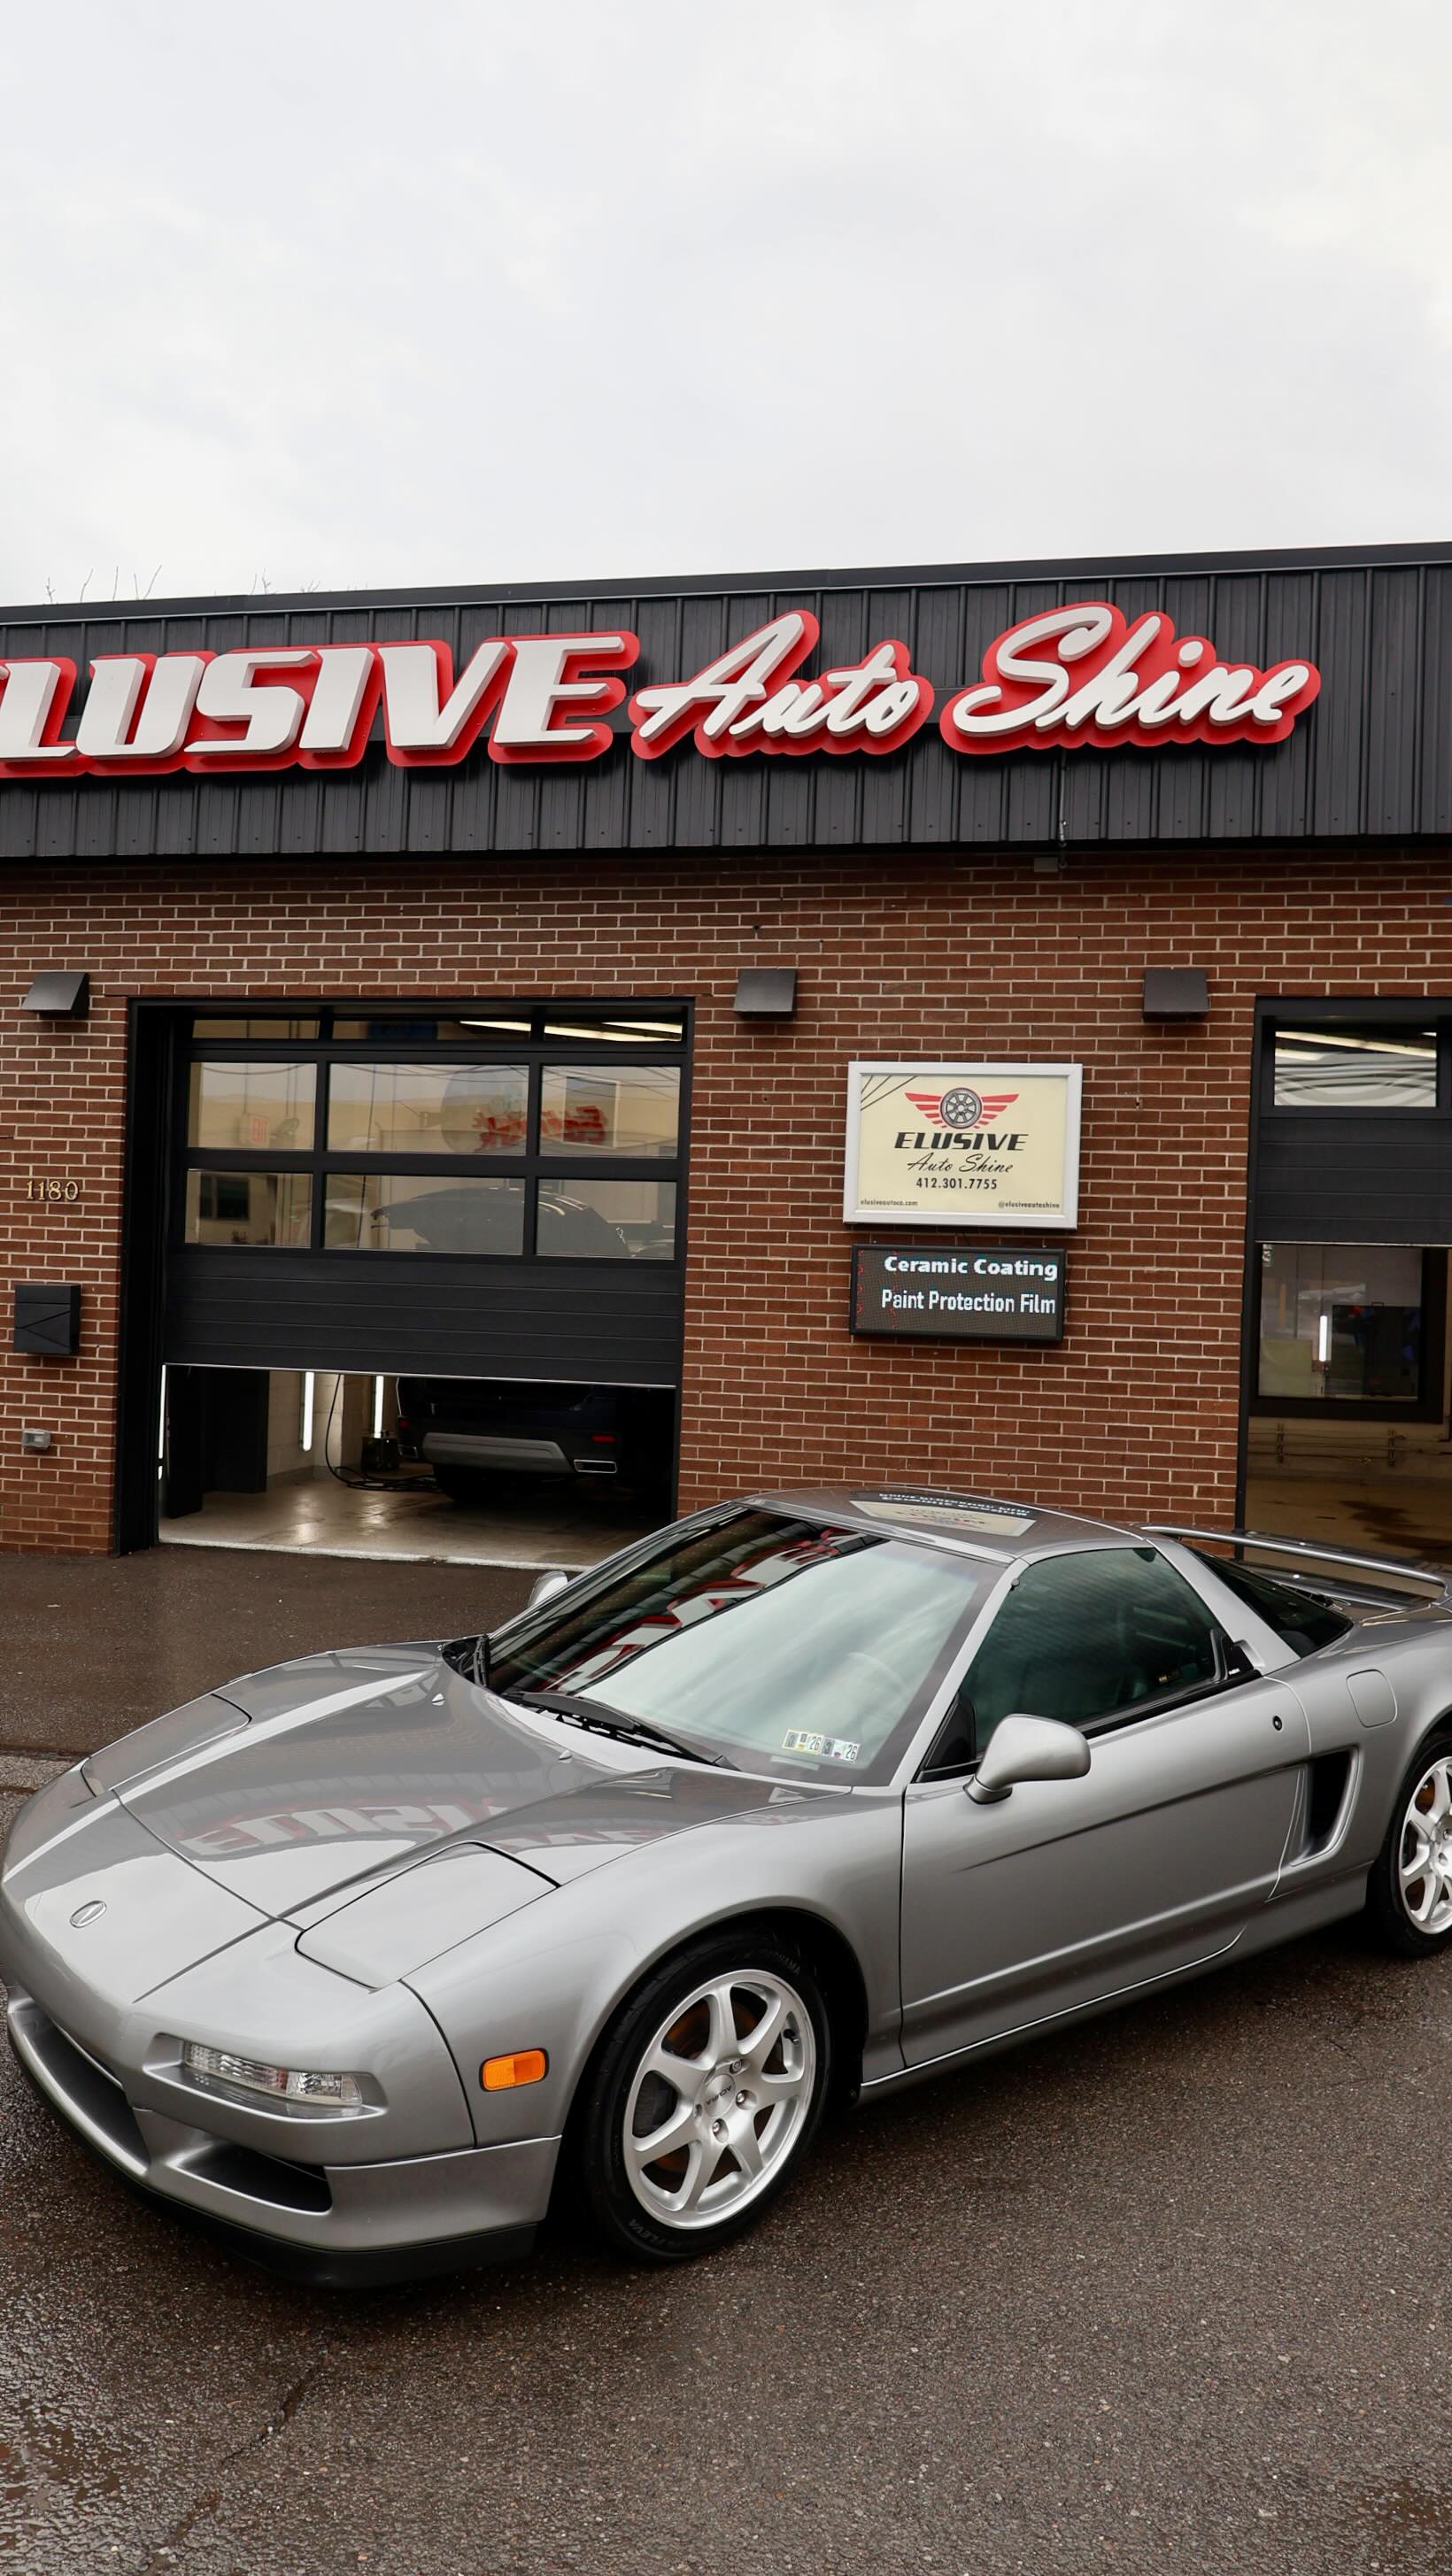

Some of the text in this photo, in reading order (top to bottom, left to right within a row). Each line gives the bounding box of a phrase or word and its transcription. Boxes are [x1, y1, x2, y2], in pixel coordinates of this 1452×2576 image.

[0, 604, 1309, 760] LUSIVE Auto Shine
[894, 1132, 1028, 1151] ELUSIVE
[907, 1153, 1013, 1174] Auto Shine
[27, 1180, 79, 1200] 1180
[915, 1178, 998, 1190] 412.301.7755
[884, 1256, 1057, 1281] Ceramic Coating
[881, 1289, 1054, 1314] Paint Protection Film
